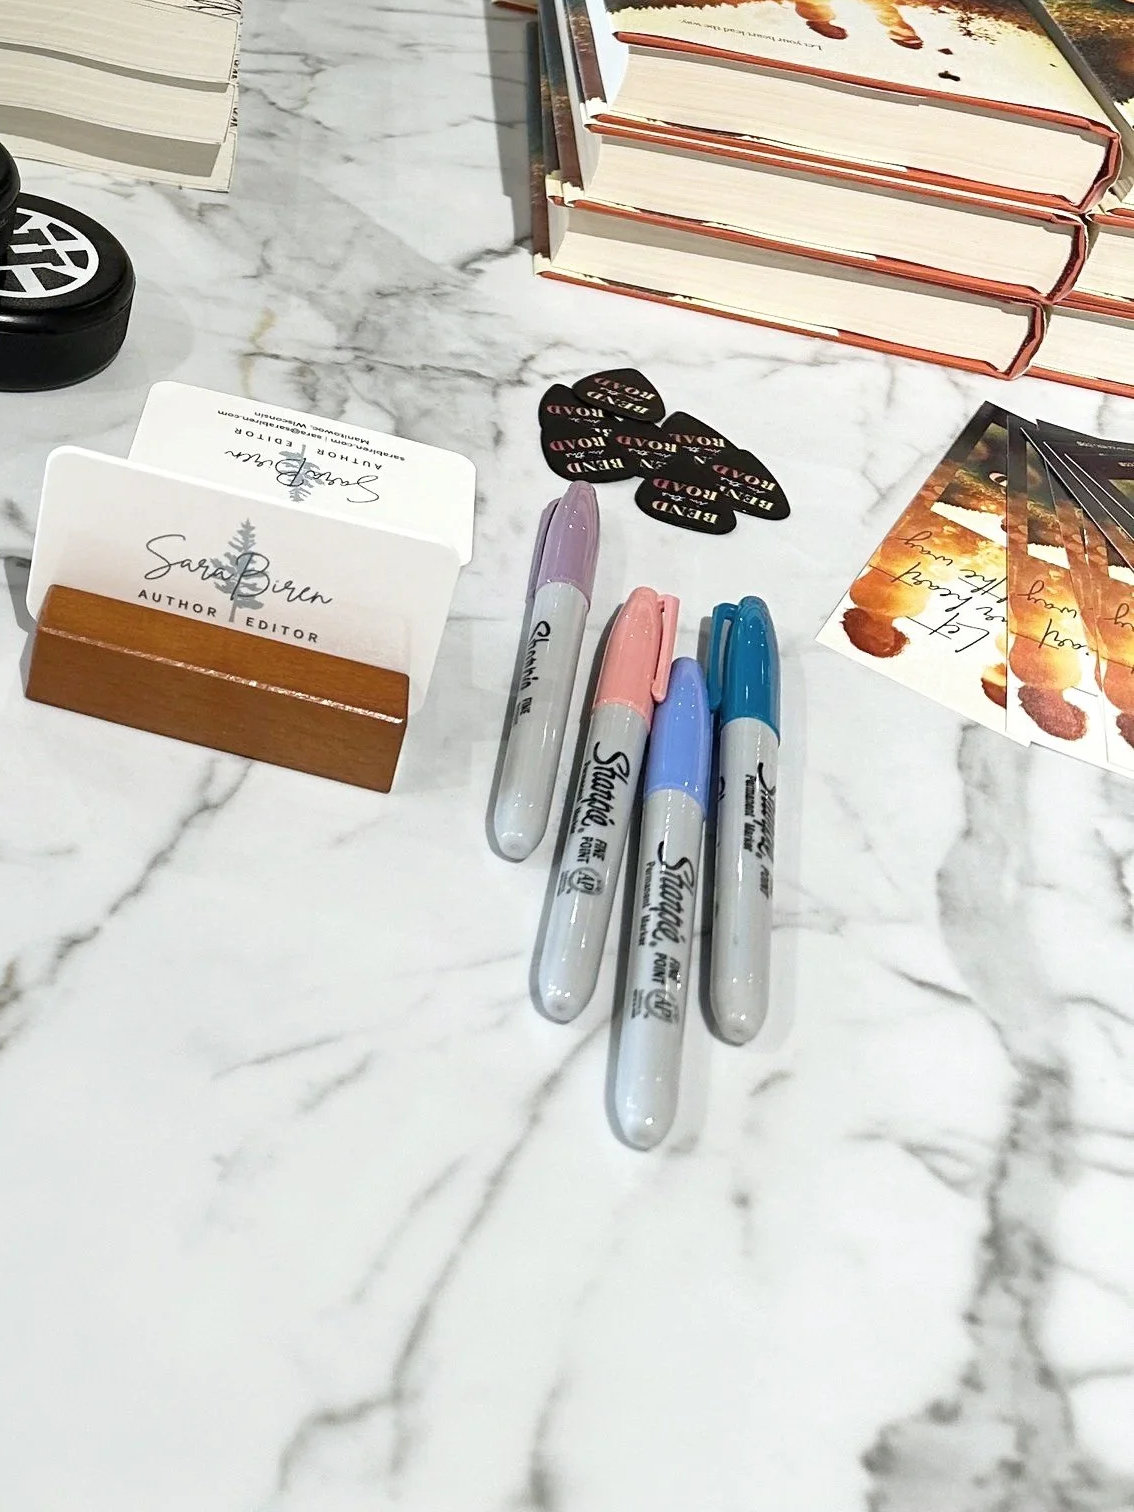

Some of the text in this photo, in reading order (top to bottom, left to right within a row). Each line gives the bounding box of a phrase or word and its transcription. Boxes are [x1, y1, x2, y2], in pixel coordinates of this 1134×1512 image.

[703, 23, 721, 33] the
[721, 27, 746, 38] lead
[745, 31, 776, 44] heart
[777, 35, 804, 48] your
[593, 377, 656, 401] ROAD
[546, 404, 604, 419] ROAD
[587, 390, 649, 415] BEND
[253, 410, 307, 429] Wisconsin
[233, 427, 293, 448] EDITOR
[330, 437, 406, 462] sarabiren.com
[549, 436, 607, 452] ROAD
[614, 435, 678, 454] ROAD
[315, 447, 383, 471] AUTHOR
[566, 457, 625, 474] BEND
[223, 449, 380, 504] Sara Biren
[712, 464, 777, 492] ROAD
[651, 478, 719, 502] ROAD
[651, 500, 718, 525] BEND
[896, 530, 954, 568] way
[144, 533, 334, 605] Sara Biren
[868, 561, 973, 613] heart
[1017, 579, 1078, 620] way
[138, 589, 217, 618] AUTHOR
[245, 616, 319, 644] EDITOR
[904, 616, 990, 653] Let
[575, 835, 595, 865] POINT
[592, 837, 609, 863] FINE
[651, 951, 667, 986] POINT
